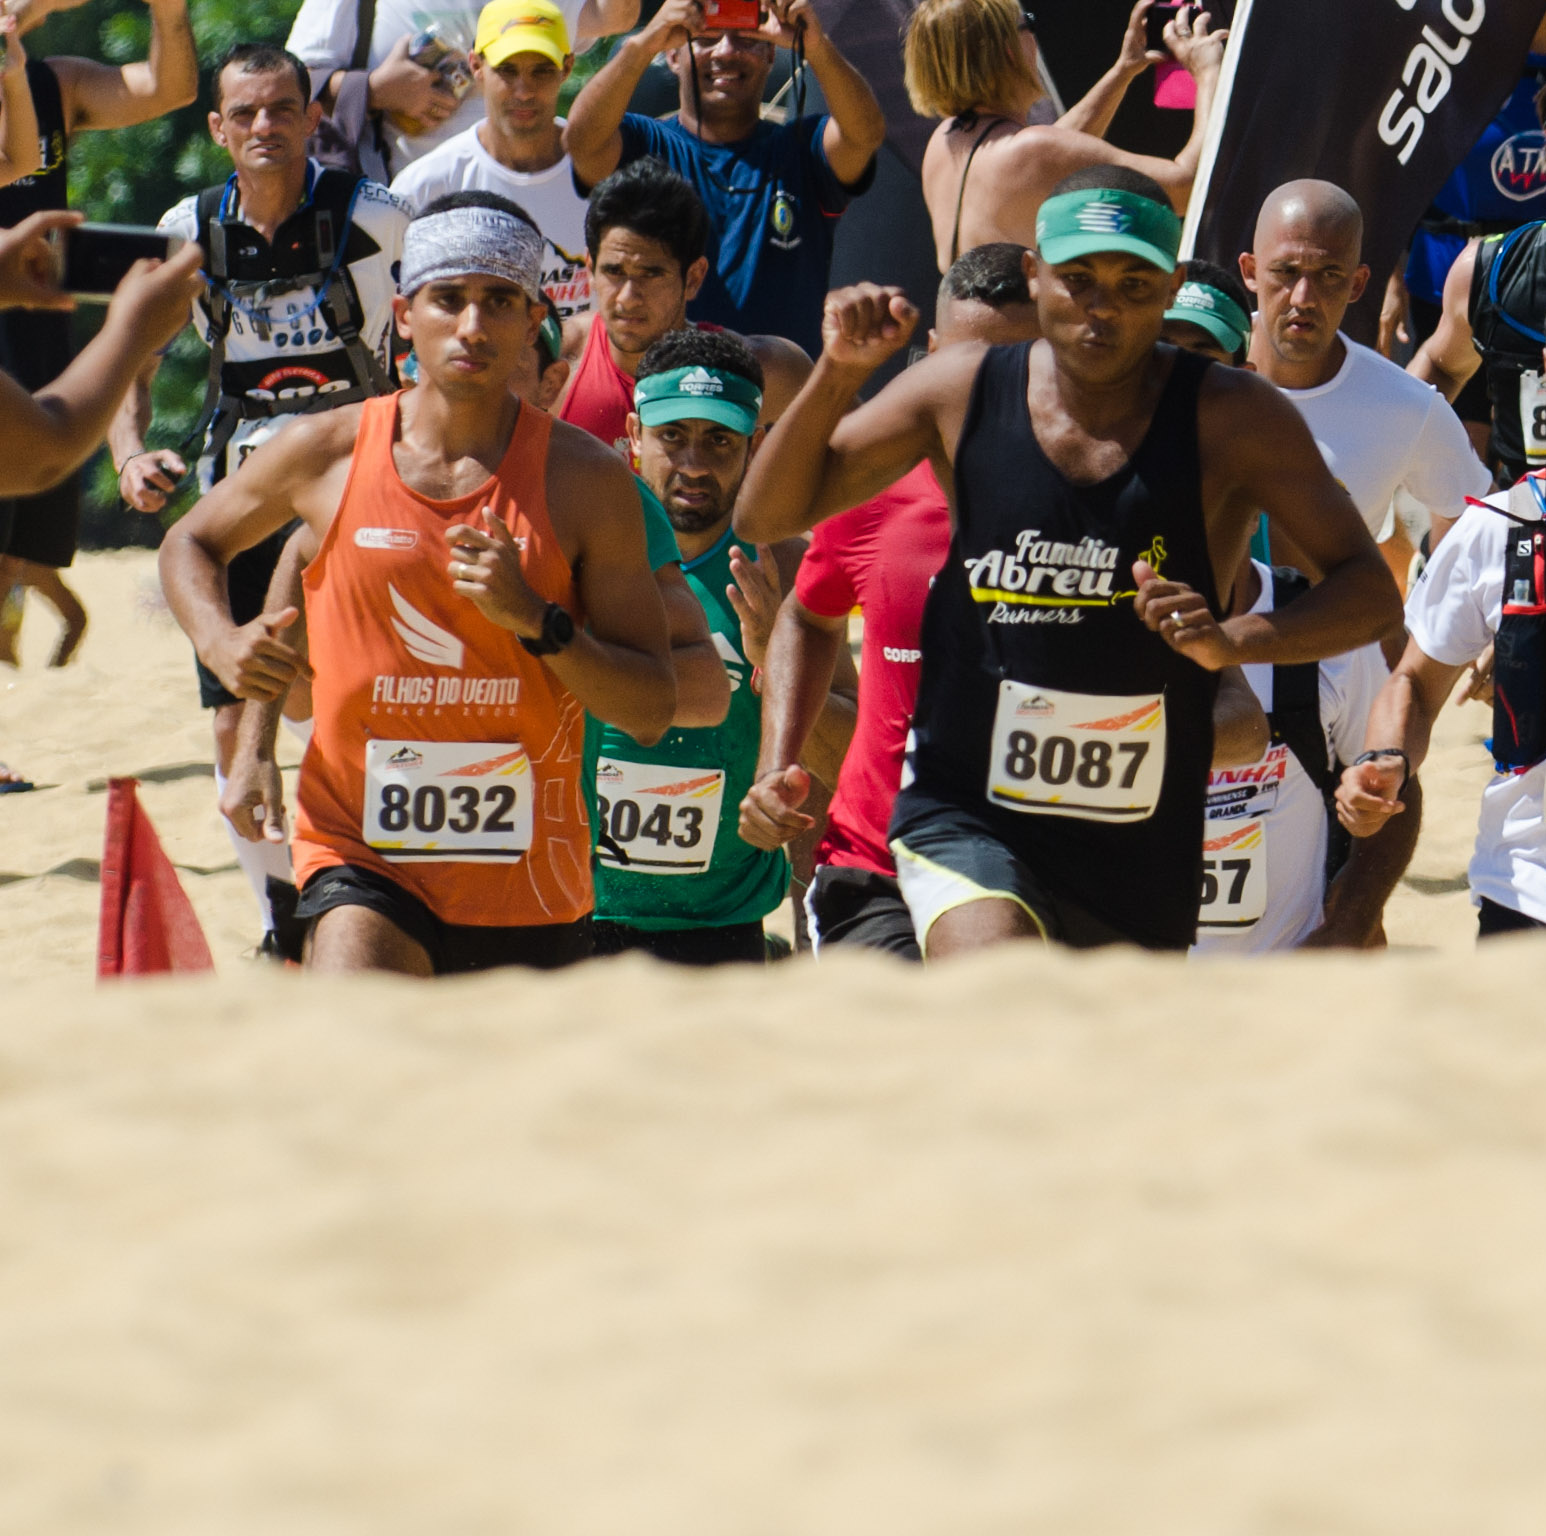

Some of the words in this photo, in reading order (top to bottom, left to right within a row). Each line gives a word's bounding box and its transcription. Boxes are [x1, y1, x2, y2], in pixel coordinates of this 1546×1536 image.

[678, 382, 723, 393] TORRES
[1015, 529, 1119, 570] Família
[964, 550, 1114, 597] Abreu
[987, 601, 1085, 624] Runners
[883, 646, 922, 663] CORP
[372, 674, 435, 704] FILHOS
[435, 675, 460, 706] DO
[463, 676, 520, 705] VENTO
[1005, 729, 1150, 789] 8087
[379, 783, 516, 834] 8032
